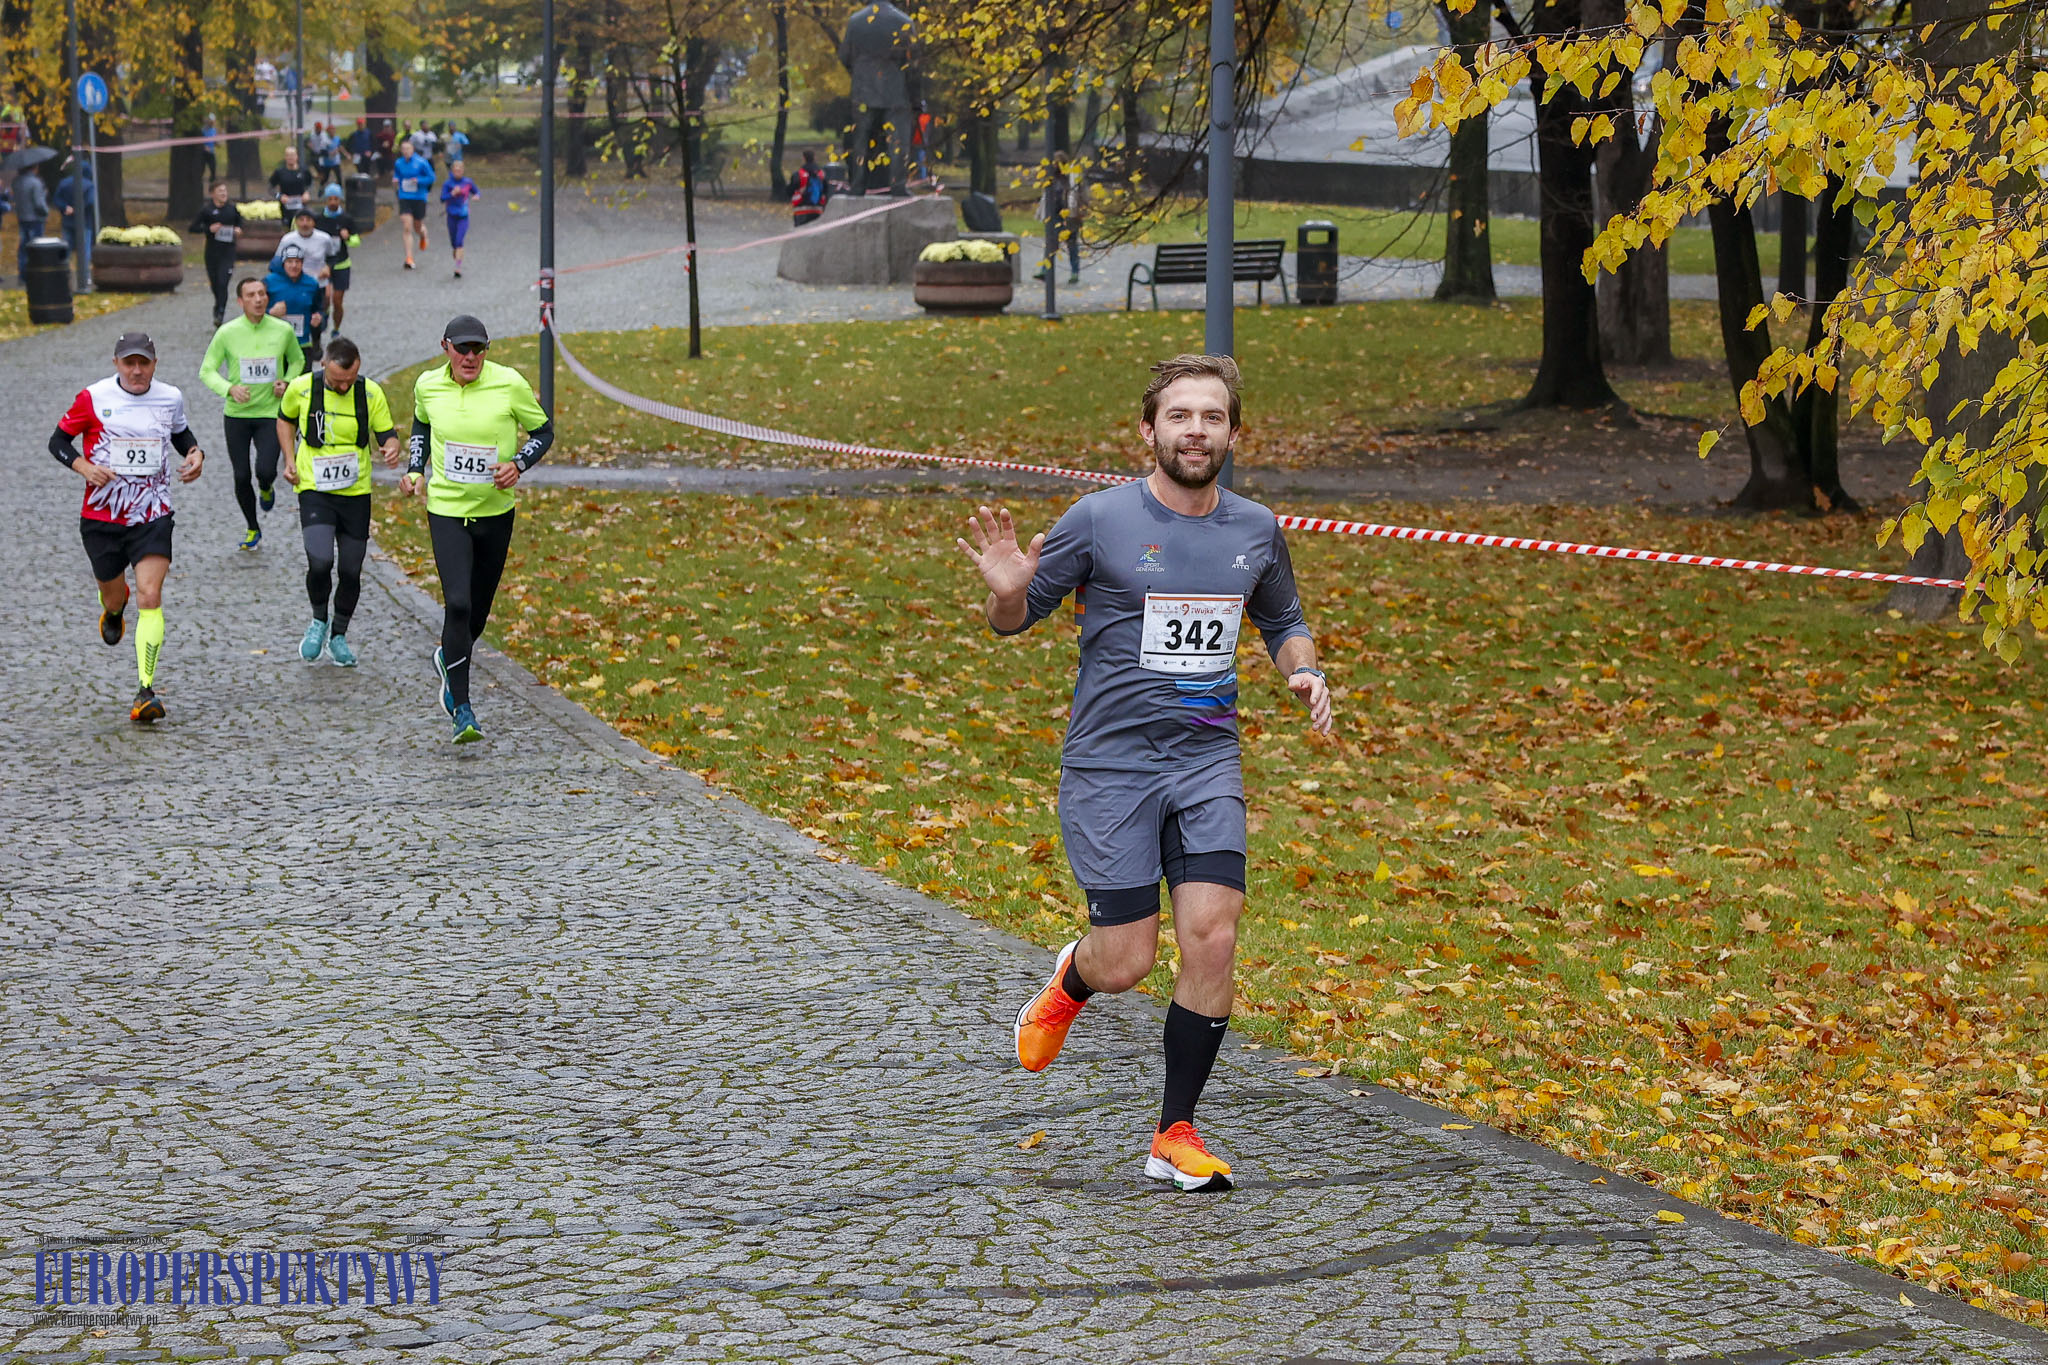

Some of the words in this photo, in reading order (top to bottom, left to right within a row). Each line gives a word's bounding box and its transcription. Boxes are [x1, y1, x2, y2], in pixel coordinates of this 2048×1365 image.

[248, 365, 269, 377] 186
[127, 449, 147, 464] 93
[454, 455, 487, 473] 545
[322, 463, 350, 480] 476
[1164, 619, 1223, 651] 342
